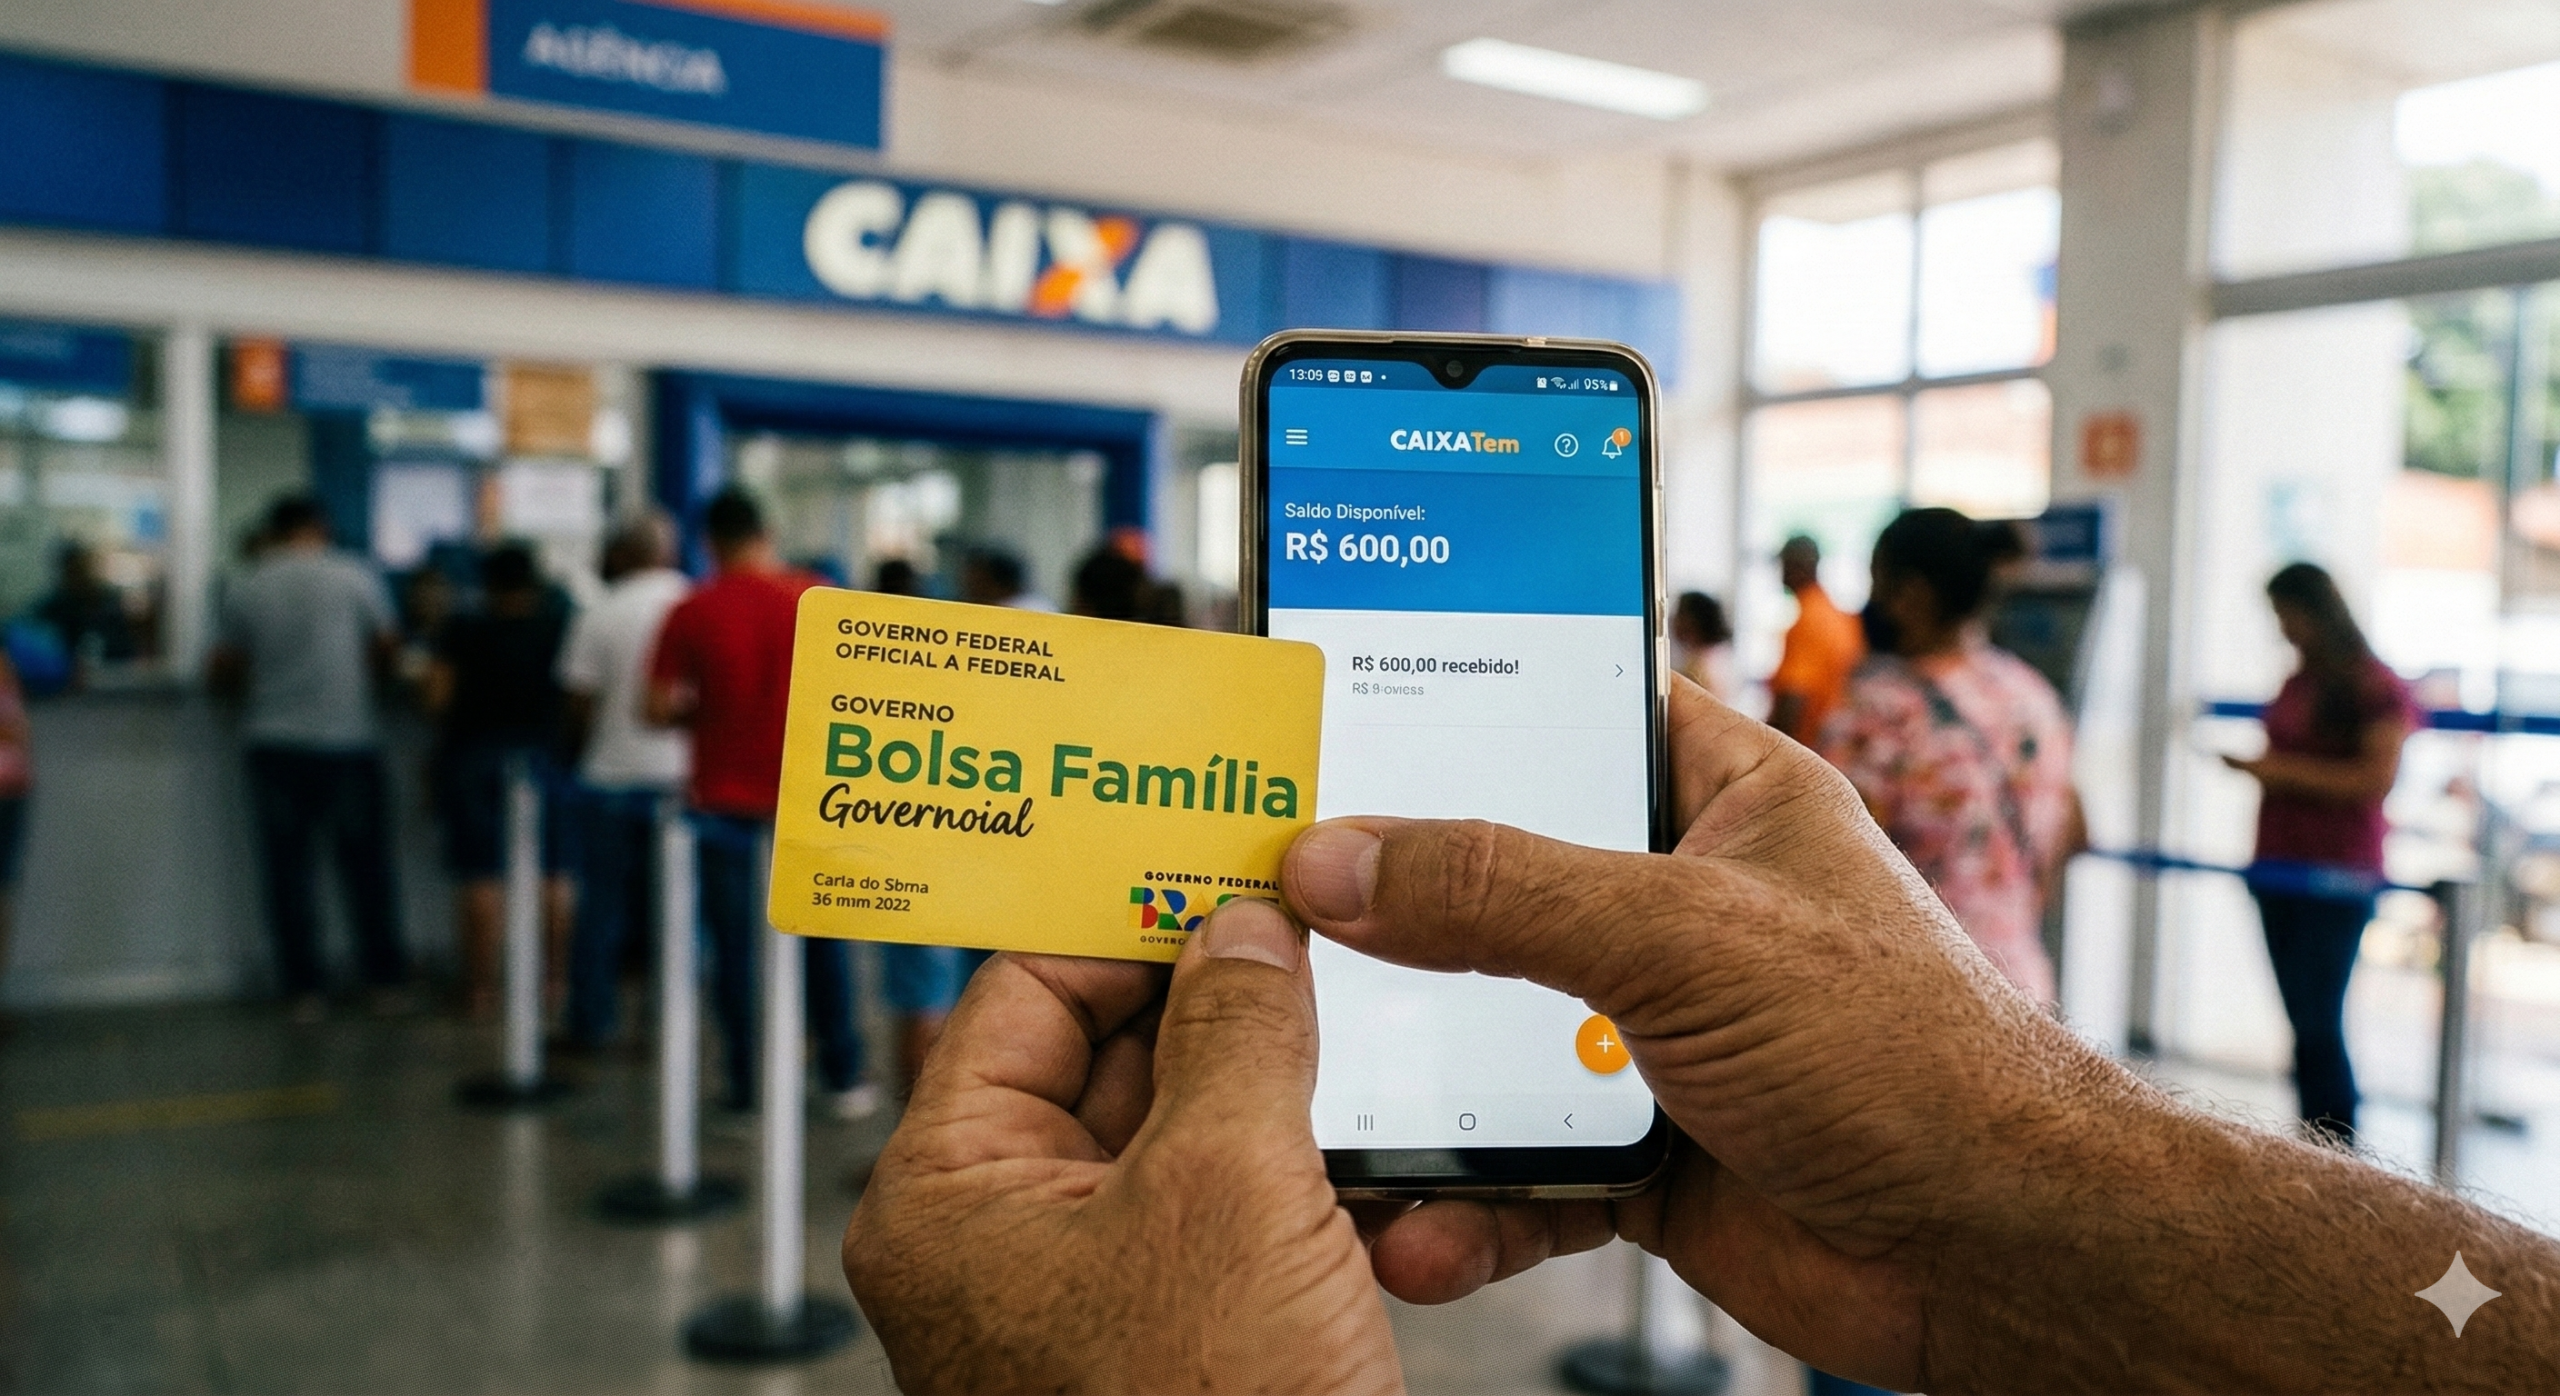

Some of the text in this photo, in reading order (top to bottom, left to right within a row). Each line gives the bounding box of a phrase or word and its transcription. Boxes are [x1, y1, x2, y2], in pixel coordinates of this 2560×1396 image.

[803, 180, 1220, 335] CAIXA
[1285, 503, 1426, 523] Saldo Disponível:
[1285, 529, 1450, 568] R$ 600,00
[837, 618, 1054, 658] GOVERNO FEDERAL
[835, 642, 1066, 683] OFFICIAL A FEDERAL
[1352, 655, 1519, 675] R$ 600,00 recebido!
[1352, 682, 1369, 695] R$
[831, 694, 954, 723] GOVERNO
[825, 722, 1299, 819] Bolsa Família
[819, 782, 1034, 838] Governoial
[859, 876, 880, 890] do
[1144, 870, 1279, 891] GOVERNO FEDERAL
[812, 892, 832, 906] 36
[875, 897, 911, 912] 2022
